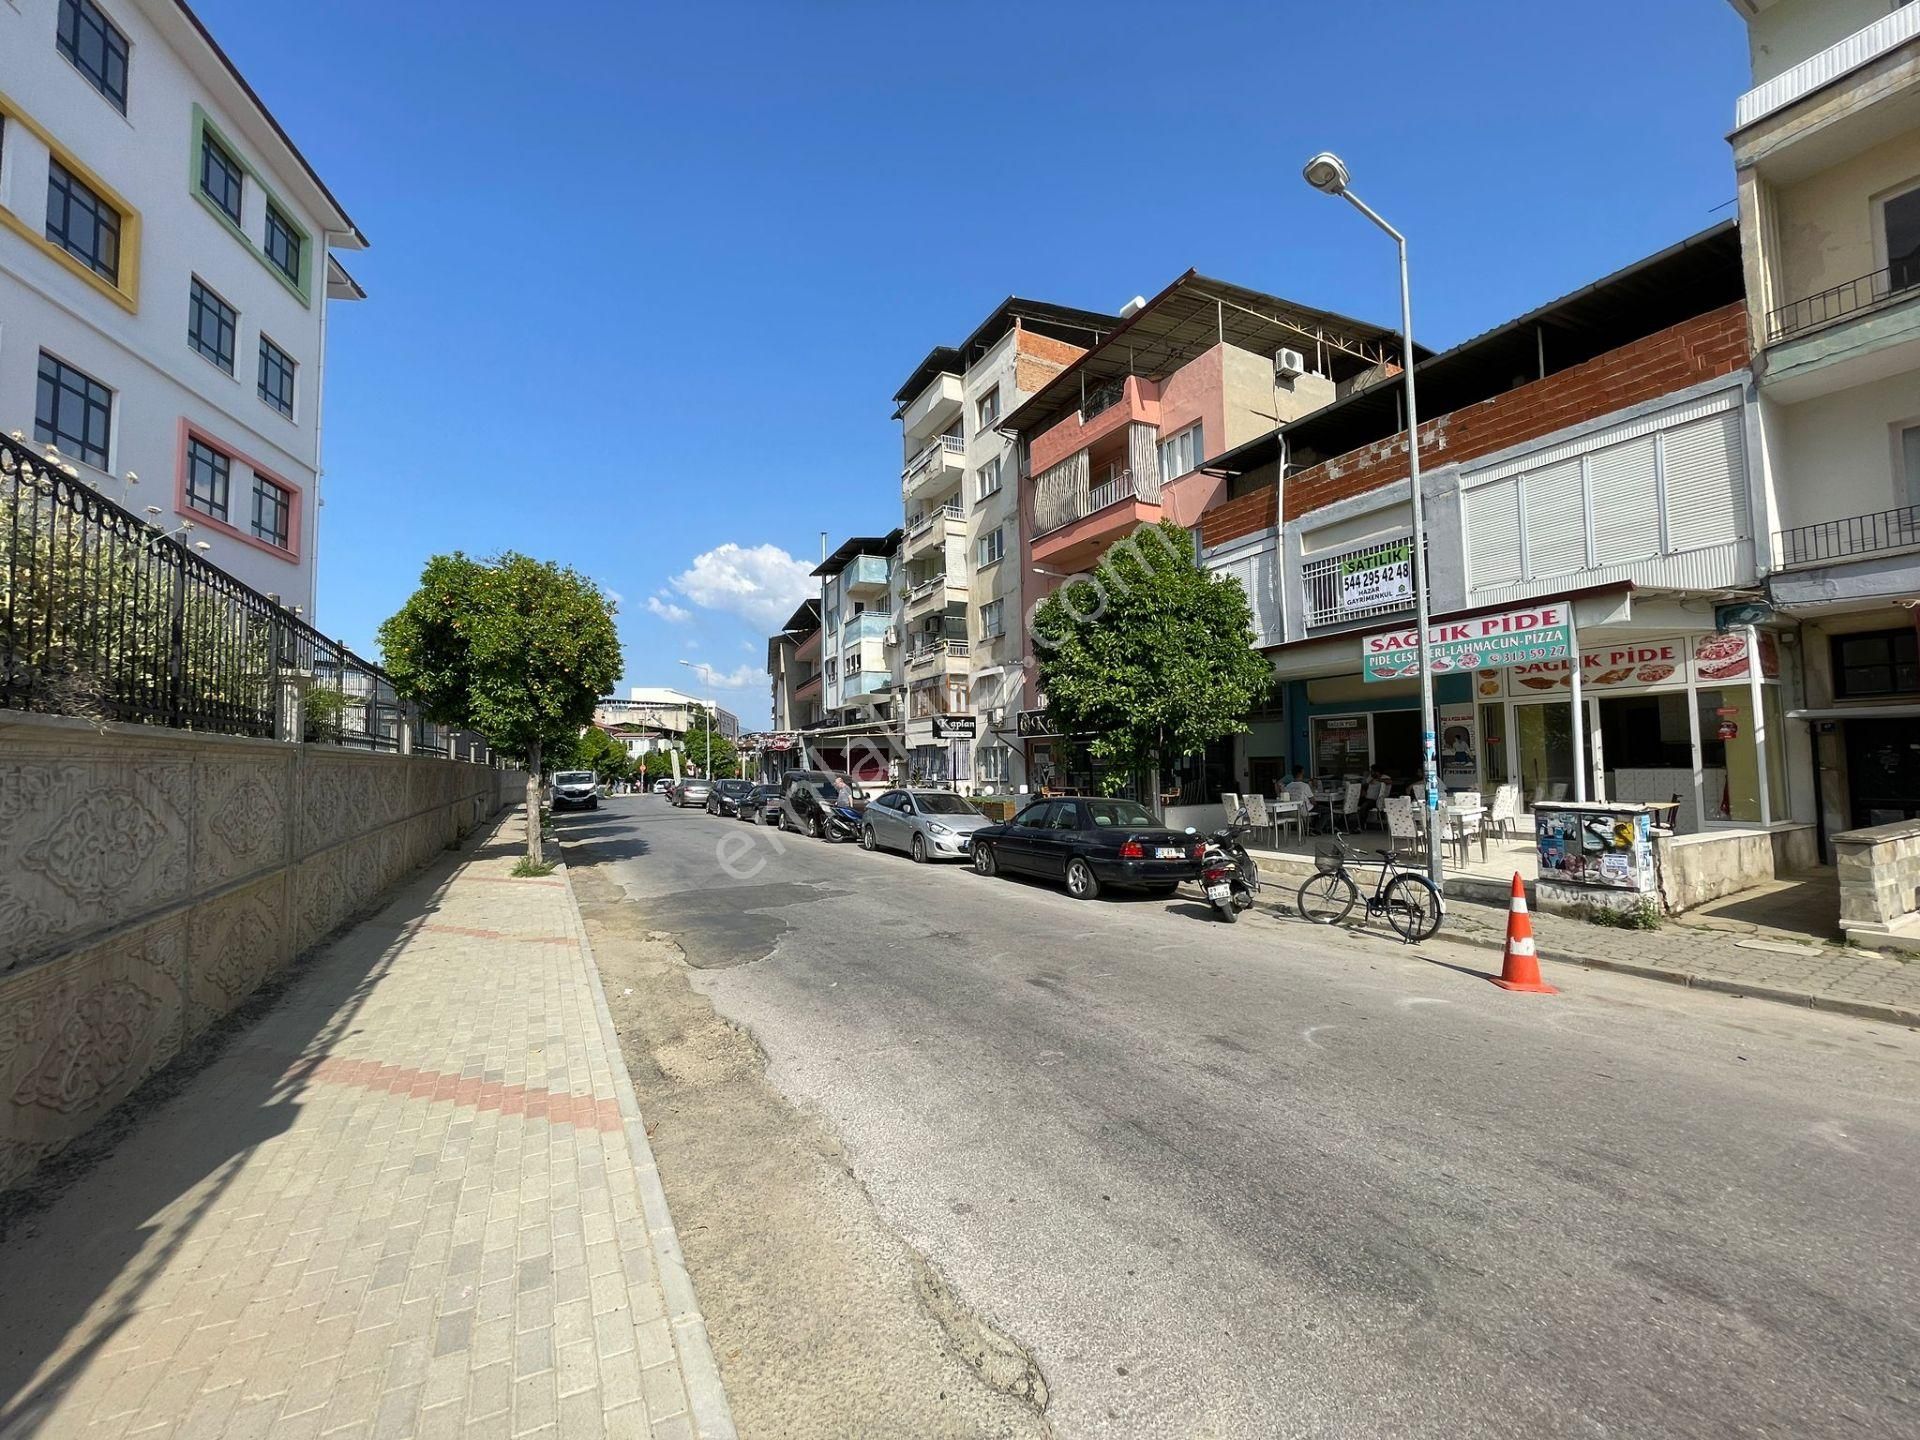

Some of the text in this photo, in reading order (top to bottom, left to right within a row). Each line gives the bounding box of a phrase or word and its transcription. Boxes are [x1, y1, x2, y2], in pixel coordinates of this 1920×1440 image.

[1348, 549, 1402, 573] SATILIK
[1344, 562, 1409, 592] 544 295 42 48
[1346, 591, 1393, 606] GAYRİMENKUL
[1358, 586, 1380, 596] HAZAR
[1370, 609, 1560, 652] SAĞLIK PİDE
[1503, 645, 1566, 662] 313 59 27
[1514, 646, 1676, 675] SALK PİDE
[936, 718, 975, 731] Kaplan
